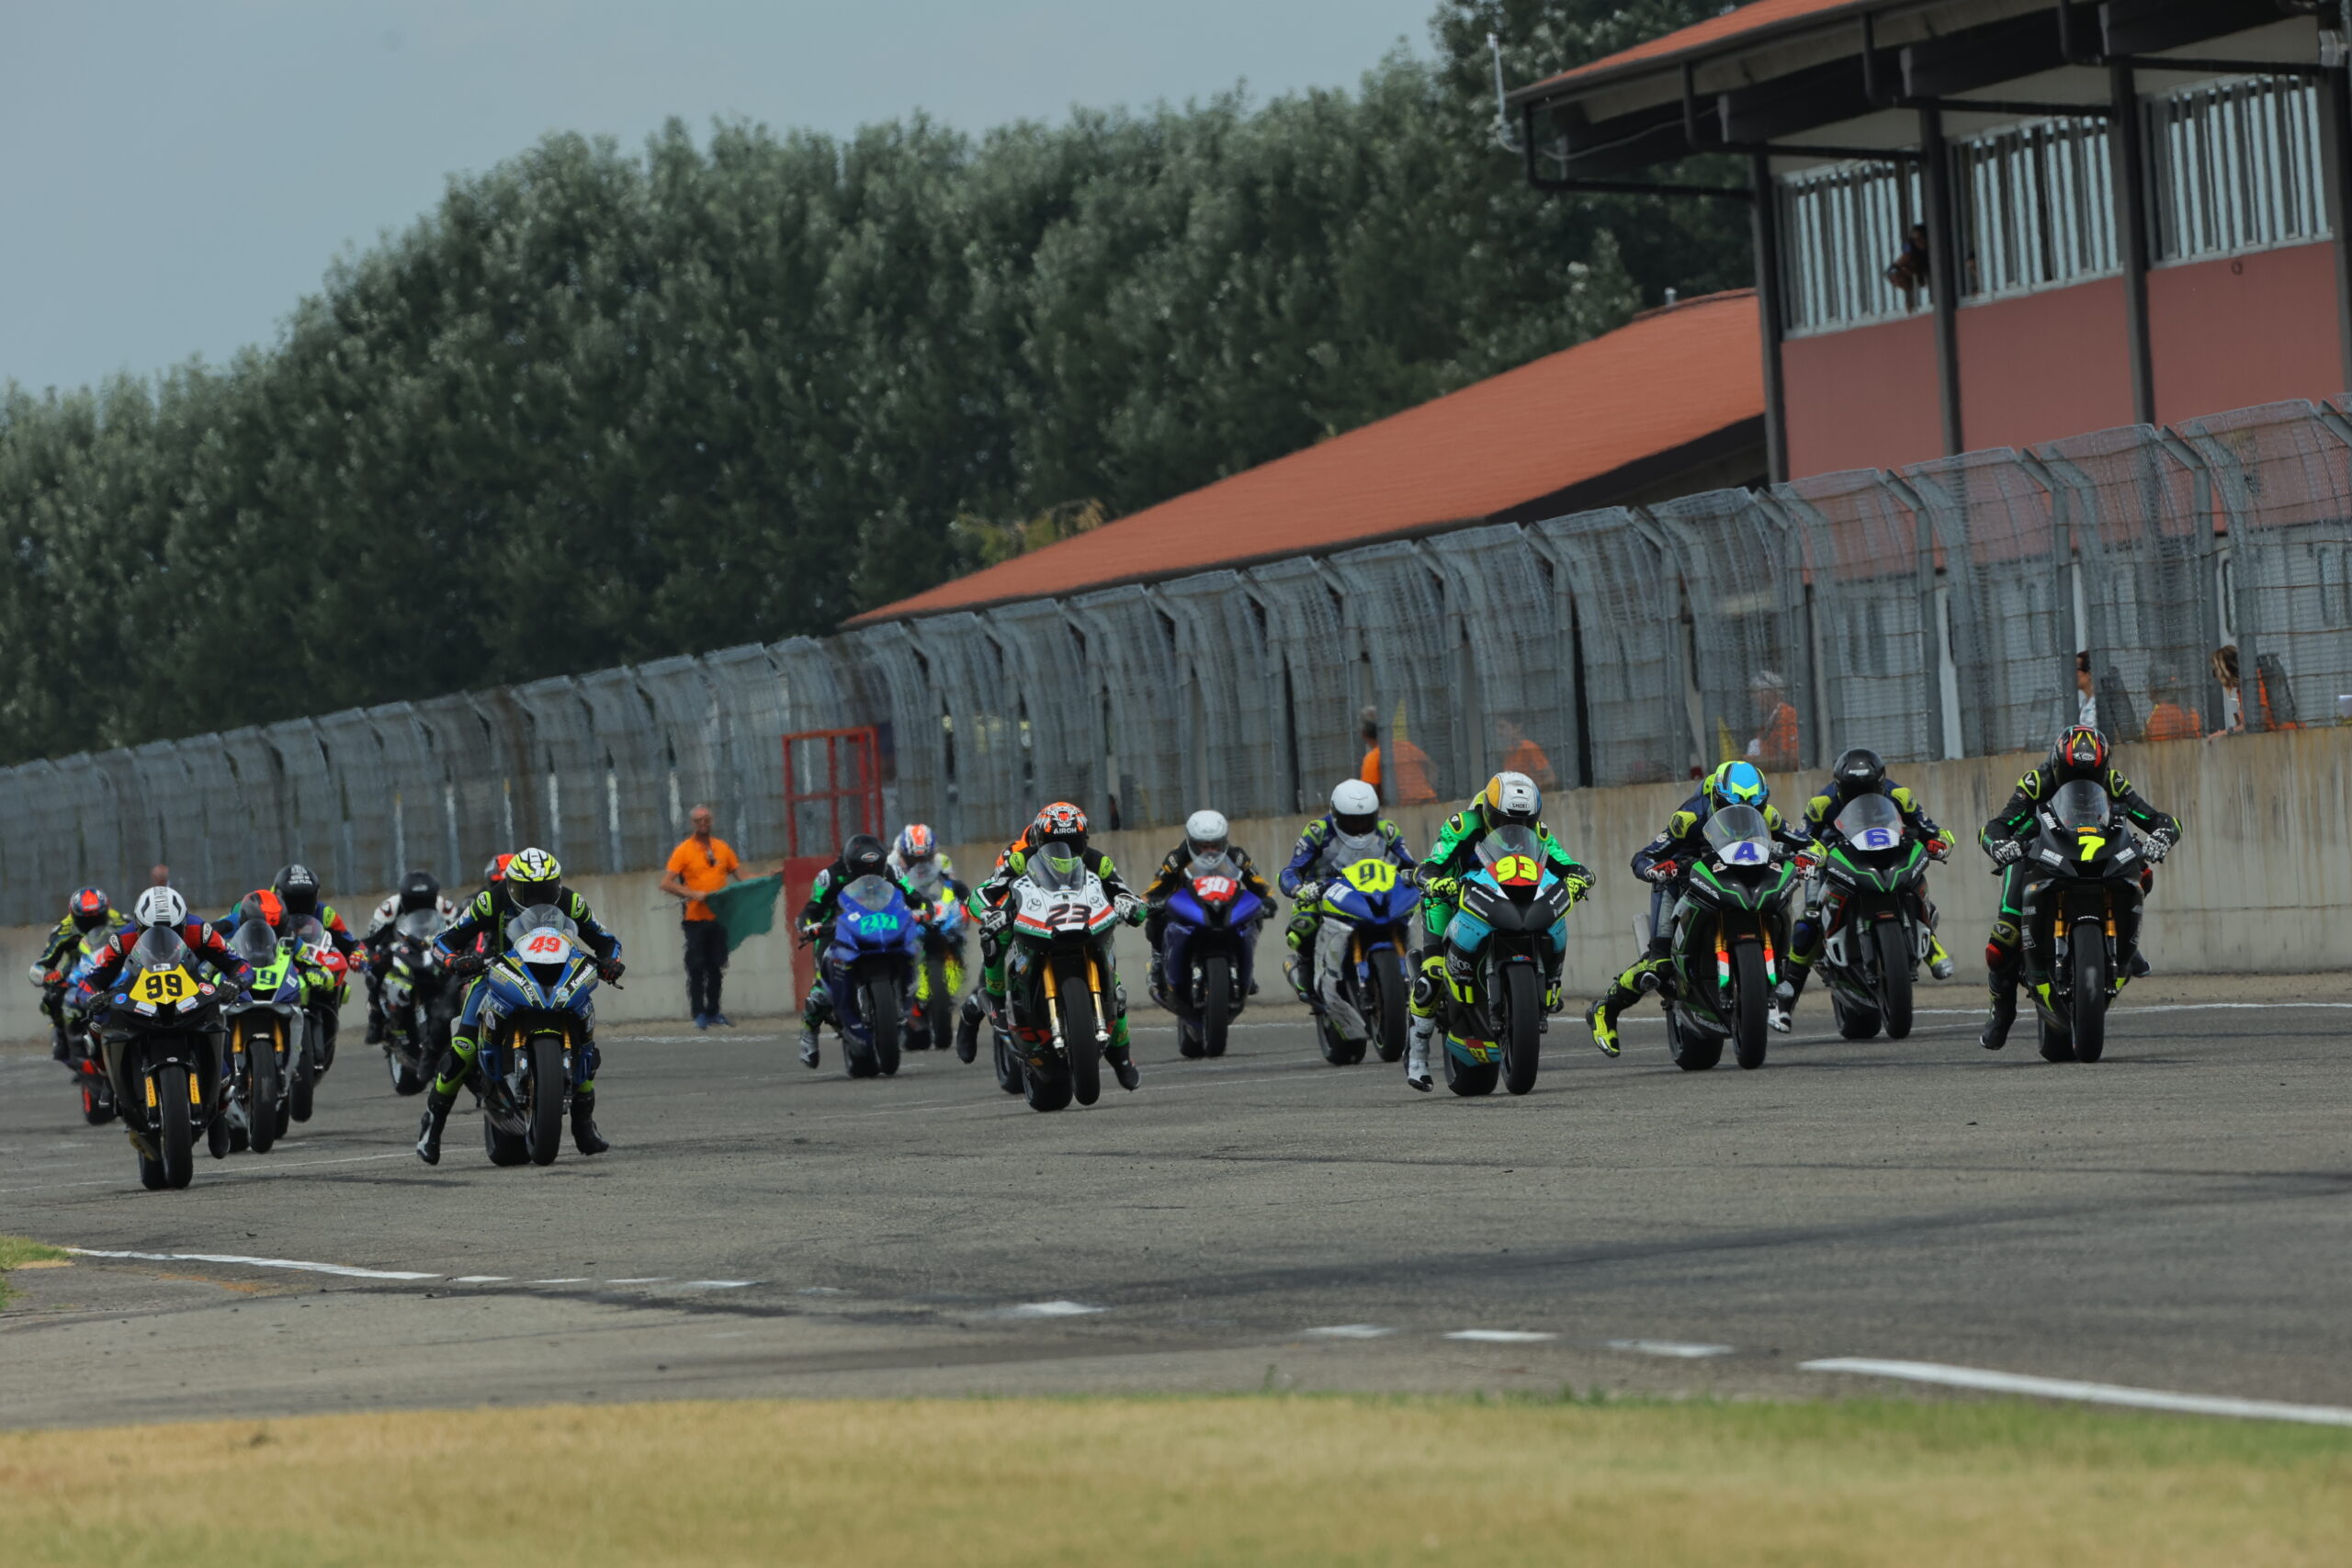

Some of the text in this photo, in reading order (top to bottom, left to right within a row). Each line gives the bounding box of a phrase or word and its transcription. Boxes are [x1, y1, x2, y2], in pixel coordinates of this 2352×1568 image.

[1864, 828, 1890, 849] 6
[2078, 835, 2105, 861] 7
[1733, 841, 1759, 862] 4
[1360, 863, 1386, 885] 91
[1496, 855, 1538, 882] 93
[1198, 877, 1230, 896] 30
[1046, 903, 1091, 927] 23
[528, 936, 561, 953] 49
[145, 974, 182, 999] 99
[496, 963, 526, 987] Kawasaki
[570, 963, 594, 988] Kawasaki
